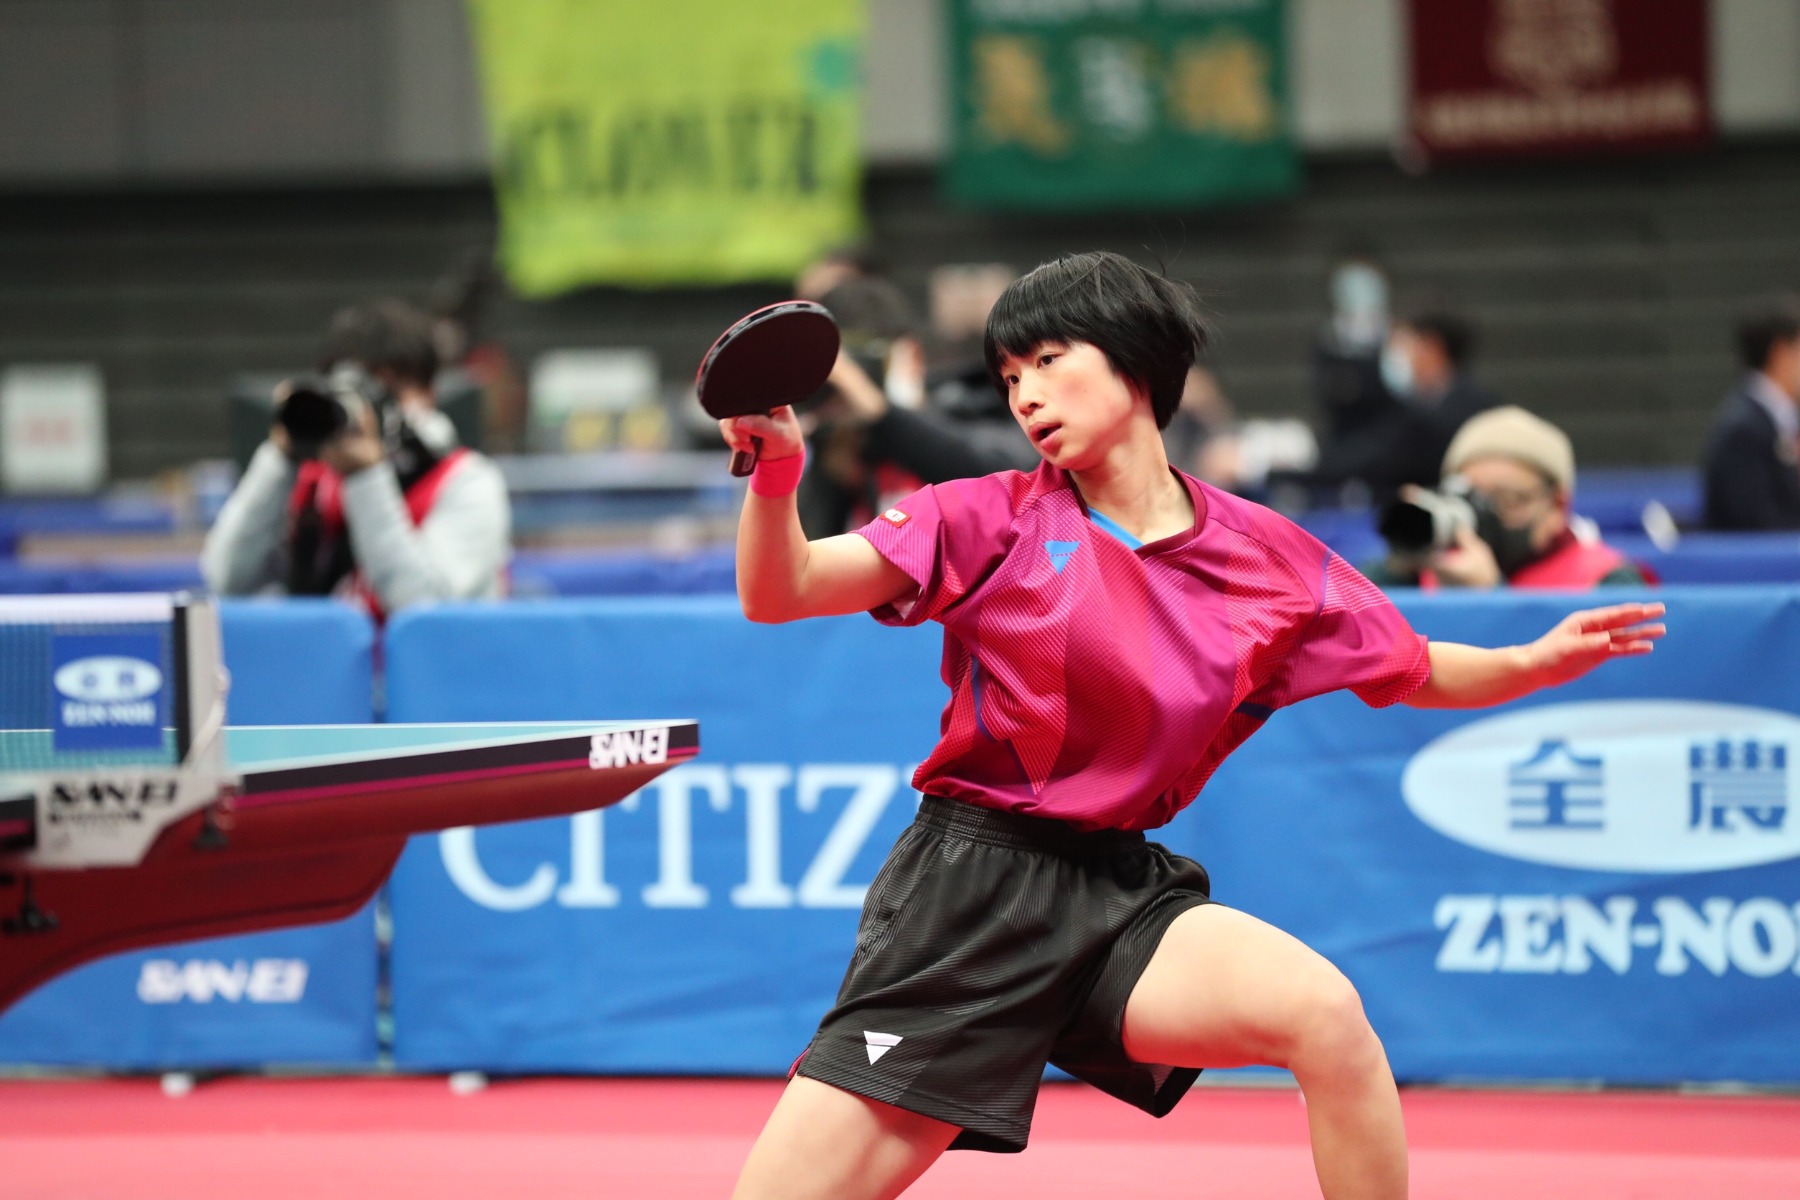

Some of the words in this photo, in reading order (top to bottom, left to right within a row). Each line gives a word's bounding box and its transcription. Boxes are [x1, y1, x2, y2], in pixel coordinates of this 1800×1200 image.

[1510, 739, 1787, 833] 全農
[439, 763, 922, 912] CITIZ
[1433, 894, 1800, 977] ZEN-NO
